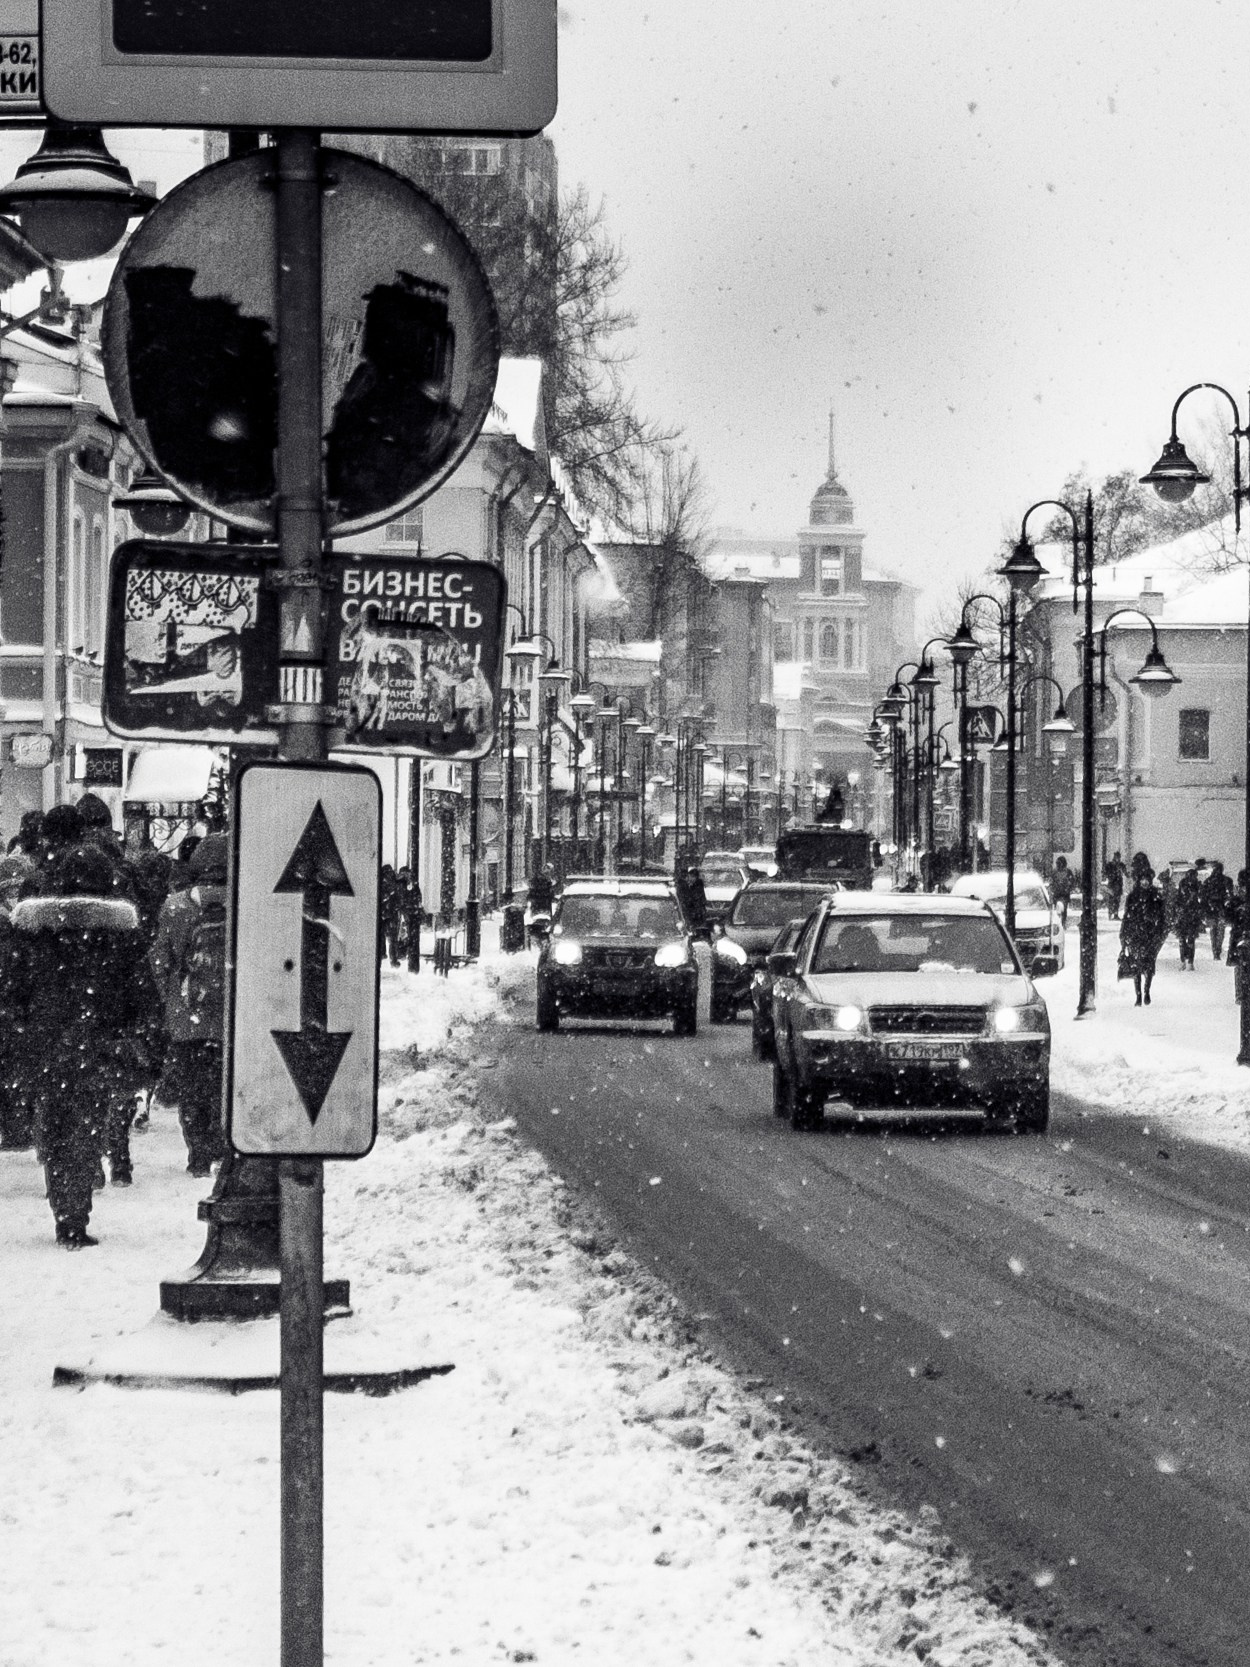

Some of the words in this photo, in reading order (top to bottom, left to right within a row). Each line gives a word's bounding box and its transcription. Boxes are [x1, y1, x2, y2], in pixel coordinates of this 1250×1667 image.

[0, 72, 36, 93] КИ
[343, 570, 473, 598] БИЗНЕС-
[387, 712, 425, 722] ДАРОМ
